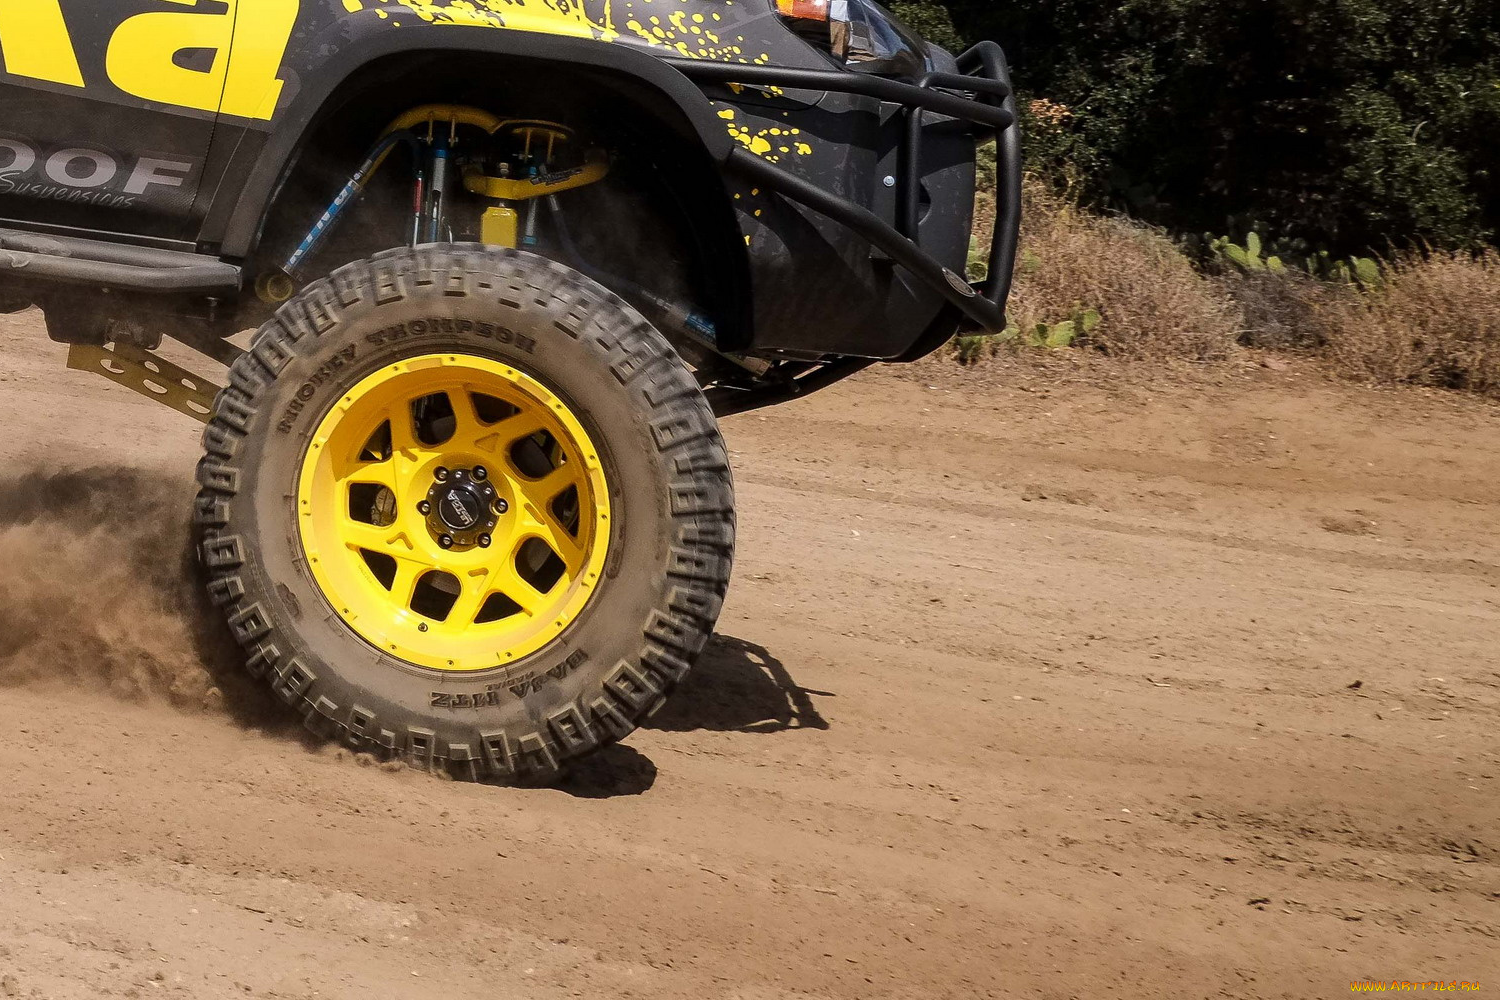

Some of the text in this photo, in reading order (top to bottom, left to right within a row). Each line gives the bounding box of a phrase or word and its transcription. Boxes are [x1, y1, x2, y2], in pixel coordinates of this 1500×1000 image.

[365, 317, 537, 354] THOMPSON
[430, 649, 589, 709] BAJA MTZ
